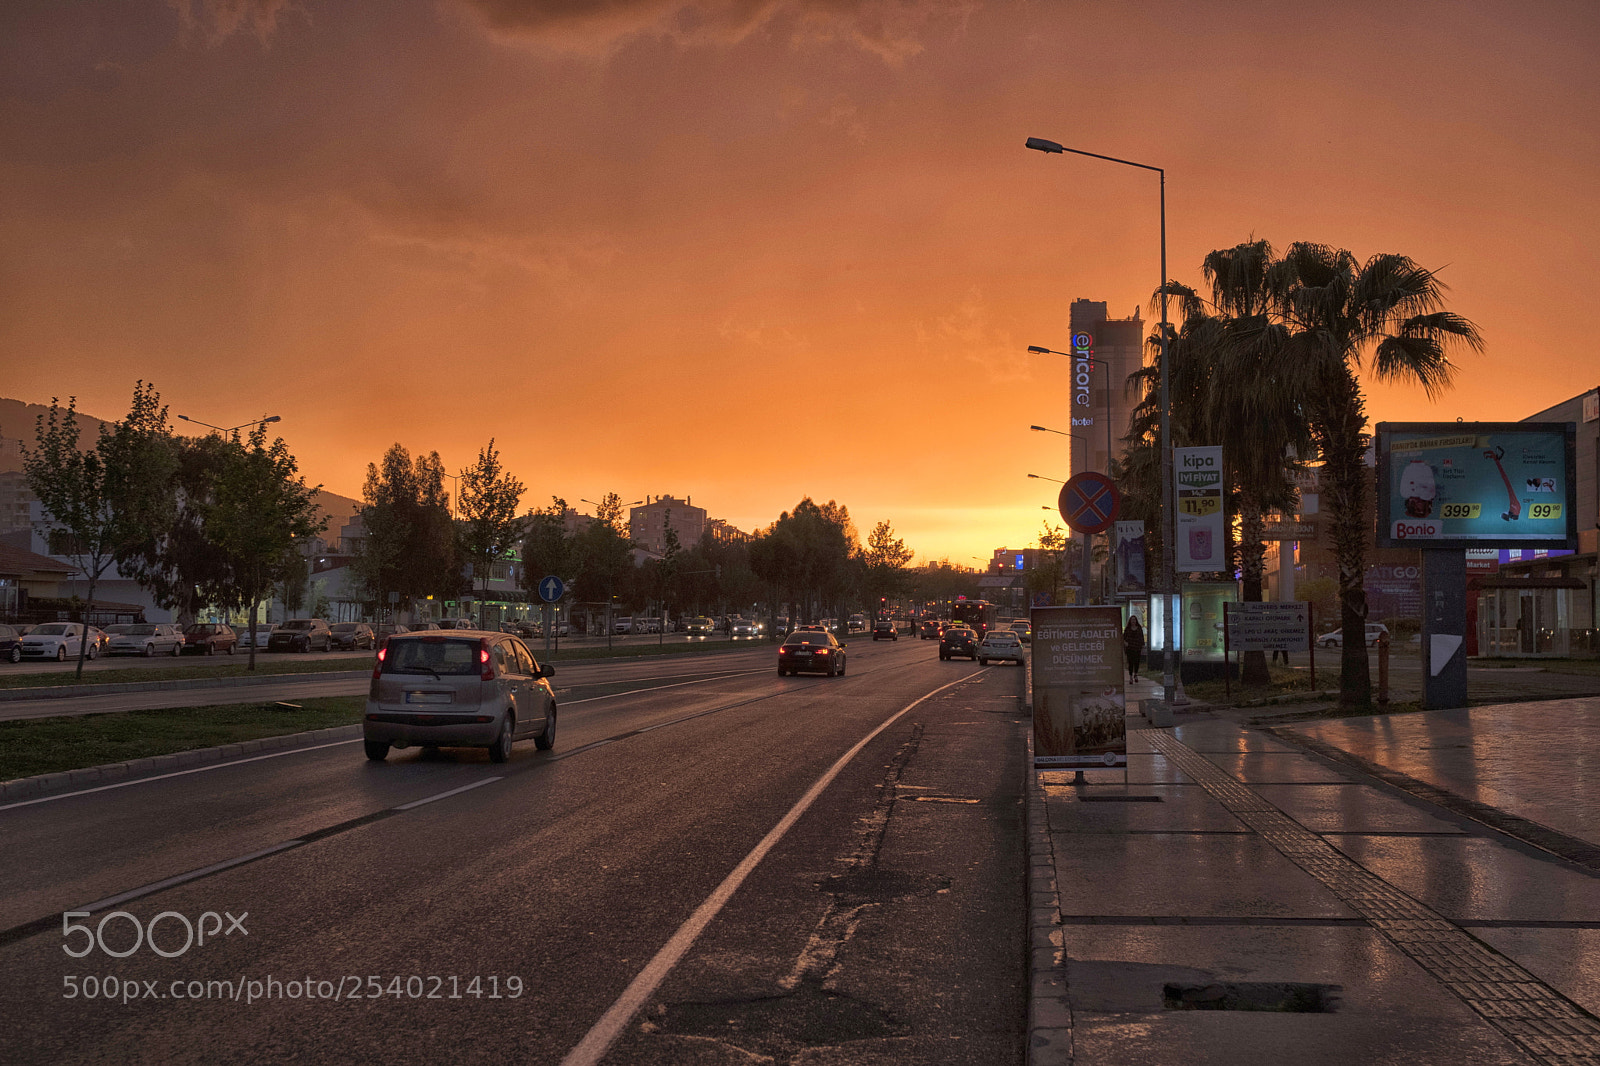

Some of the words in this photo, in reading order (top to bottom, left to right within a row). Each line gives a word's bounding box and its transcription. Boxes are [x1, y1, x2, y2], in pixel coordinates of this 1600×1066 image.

[1076, 334, 1090, 405] encore
[1072, 417, 1094, 426] hotel
[1183, 454, 1214, 469] kipa
[1180, 472, 1192, 482] İYİ
[1193, 471, 1219, 482] FİYAT
[1396, 523, 1436, 539] Banio
[1037, 628, 1079, 640] EĞİTİMDE
[1080, 627, 1118, 639] ADALETİ
[1062, 640, 1105, 651] GELECEĞİ
[1053, 654, 1103, 665] DÜŞÜNMEK
